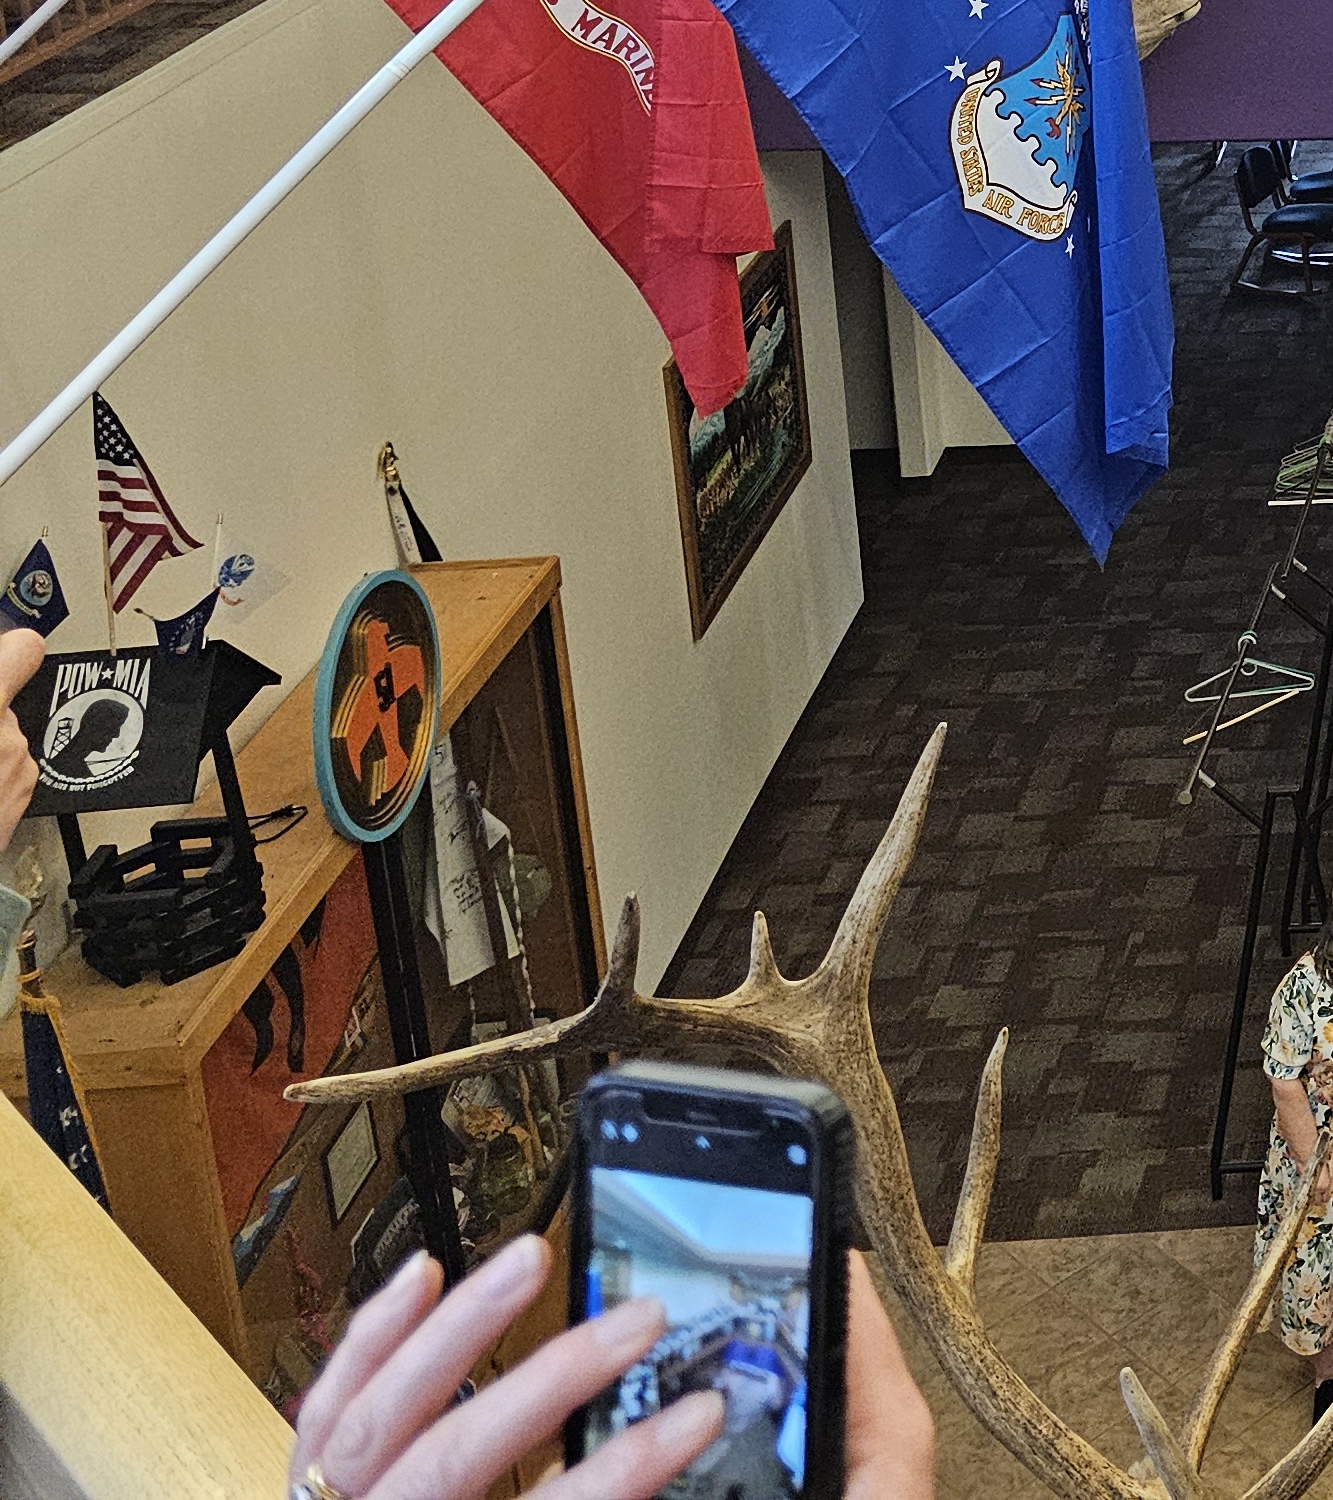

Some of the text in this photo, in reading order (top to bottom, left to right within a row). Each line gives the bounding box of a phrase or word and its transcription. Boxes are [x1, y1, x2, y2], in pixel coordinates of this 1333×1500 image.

[570, 8, 655, 103] MARIN
[957, 87, 1065, 235] UNITED STATES AIR FORCE
[50, 658, 151, 717] POW MIA
[68, 784, 86, 792] NOT
